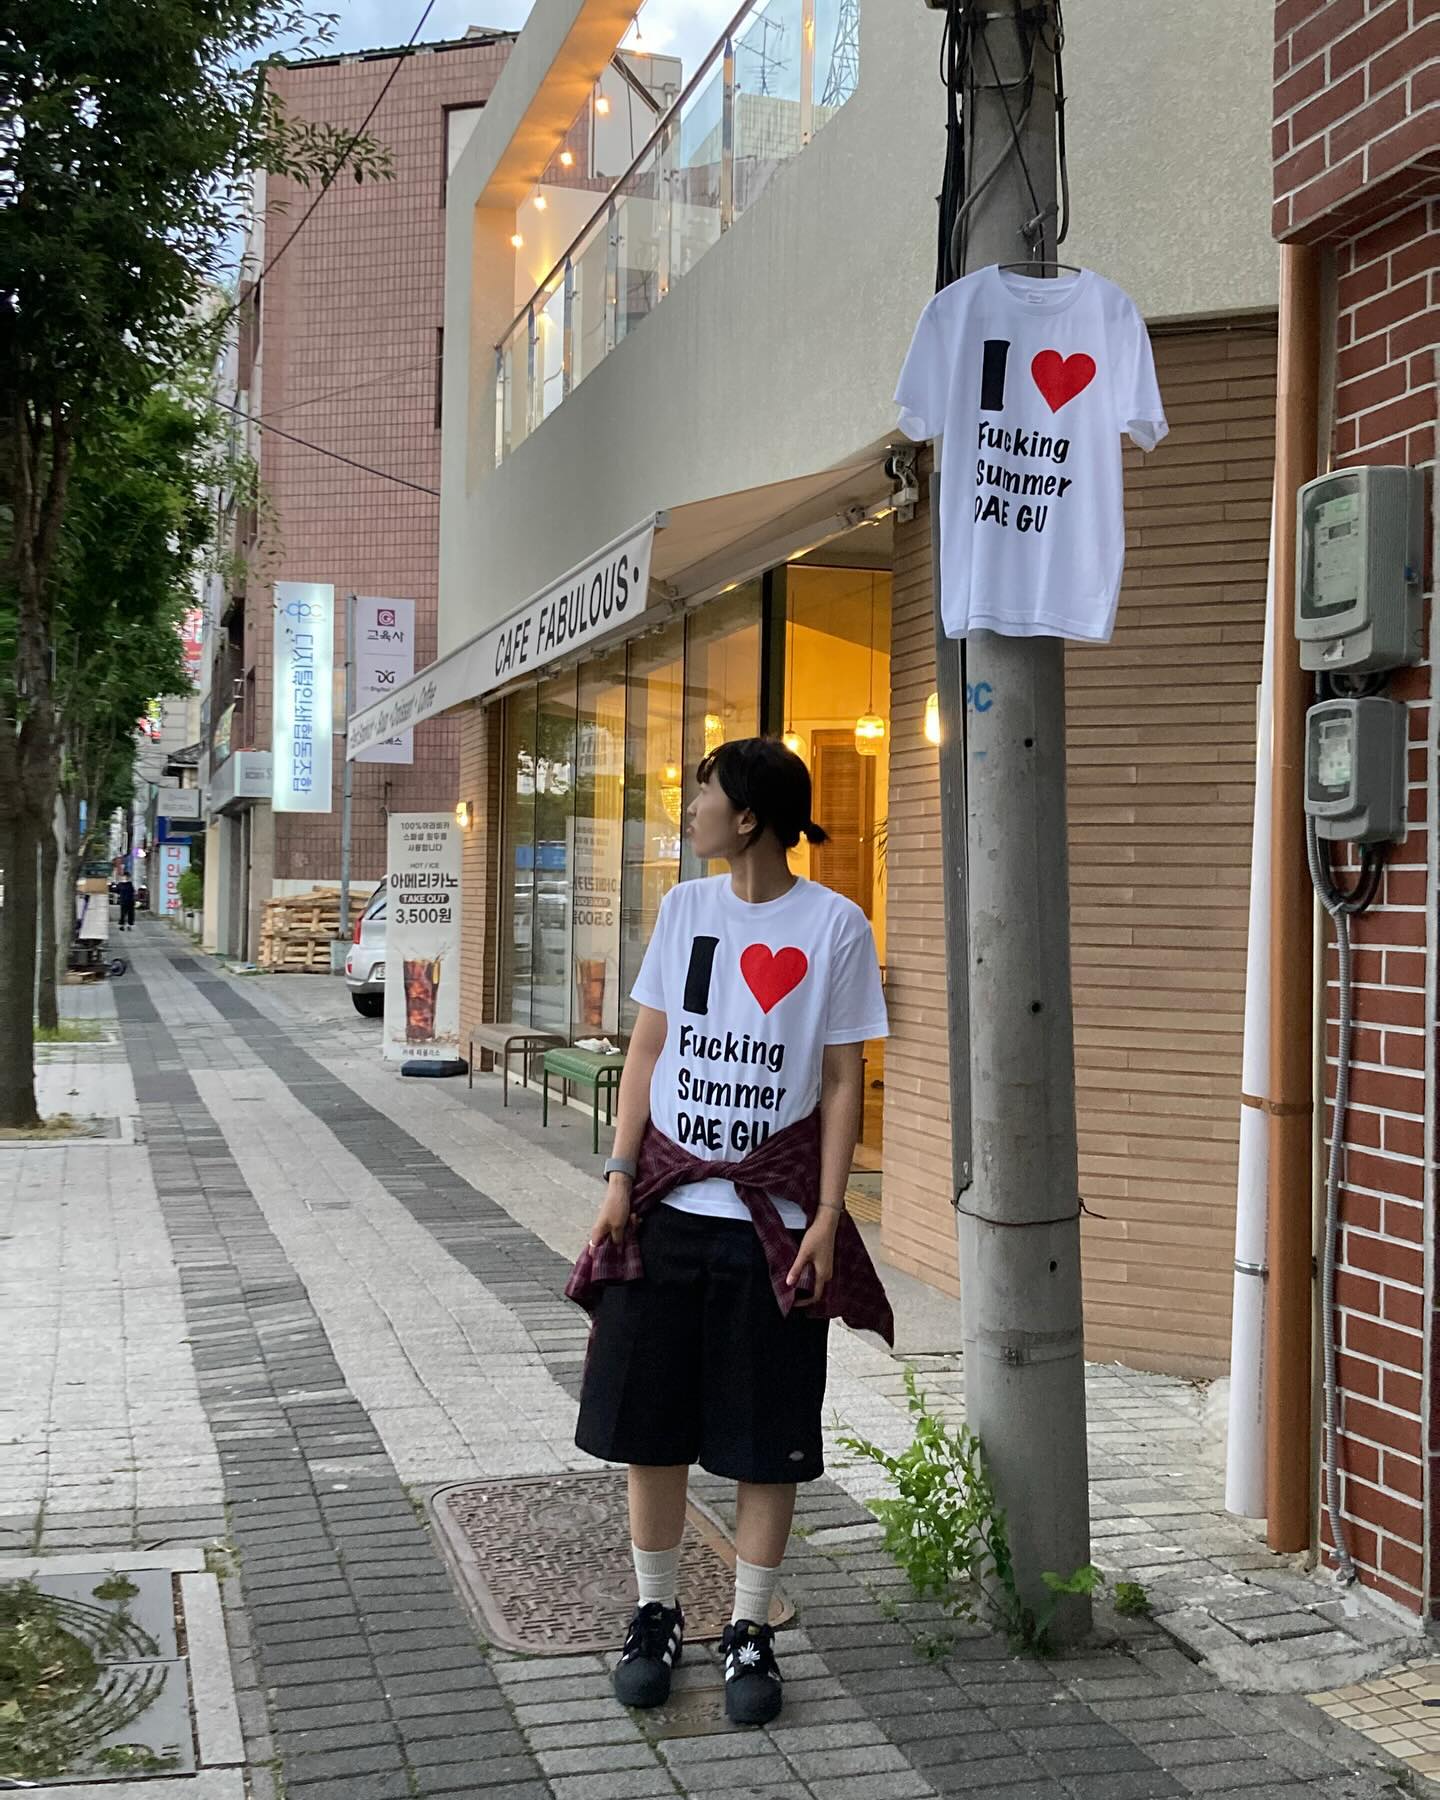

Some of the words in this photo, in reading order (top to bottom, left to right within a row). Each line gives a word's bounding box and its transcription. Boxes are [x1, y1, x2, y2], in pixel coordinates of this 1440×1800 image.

[980, 339, 1011, 412] I
[978, 421, 1070, 464] Fucking
[976, 459, 1073, 498] Summer
[1016, 504, 1048, 533] GU
[367, 629, 404, 643] 교육사
[494, 617, 532, 677] CAFE
[536, 554, 628, 656] FABULOUS
[292, 633, 314, 795] 디지털인쇄협동조합
[391, 872, 459, 889] 아메리카노
[402, 894, 426, 903] TAKE
[427, 894, 447, 903] OUT
[395, 907, 452, 925] 3,500원
[683, 935, 720, 1016] I
[679, 1024, 785, 1073] Fucking
[677, 1067, 787, 1112] Summer
[677, 1111, 722, 1151] DAE
[730, 1118, 770, 1152] GU
